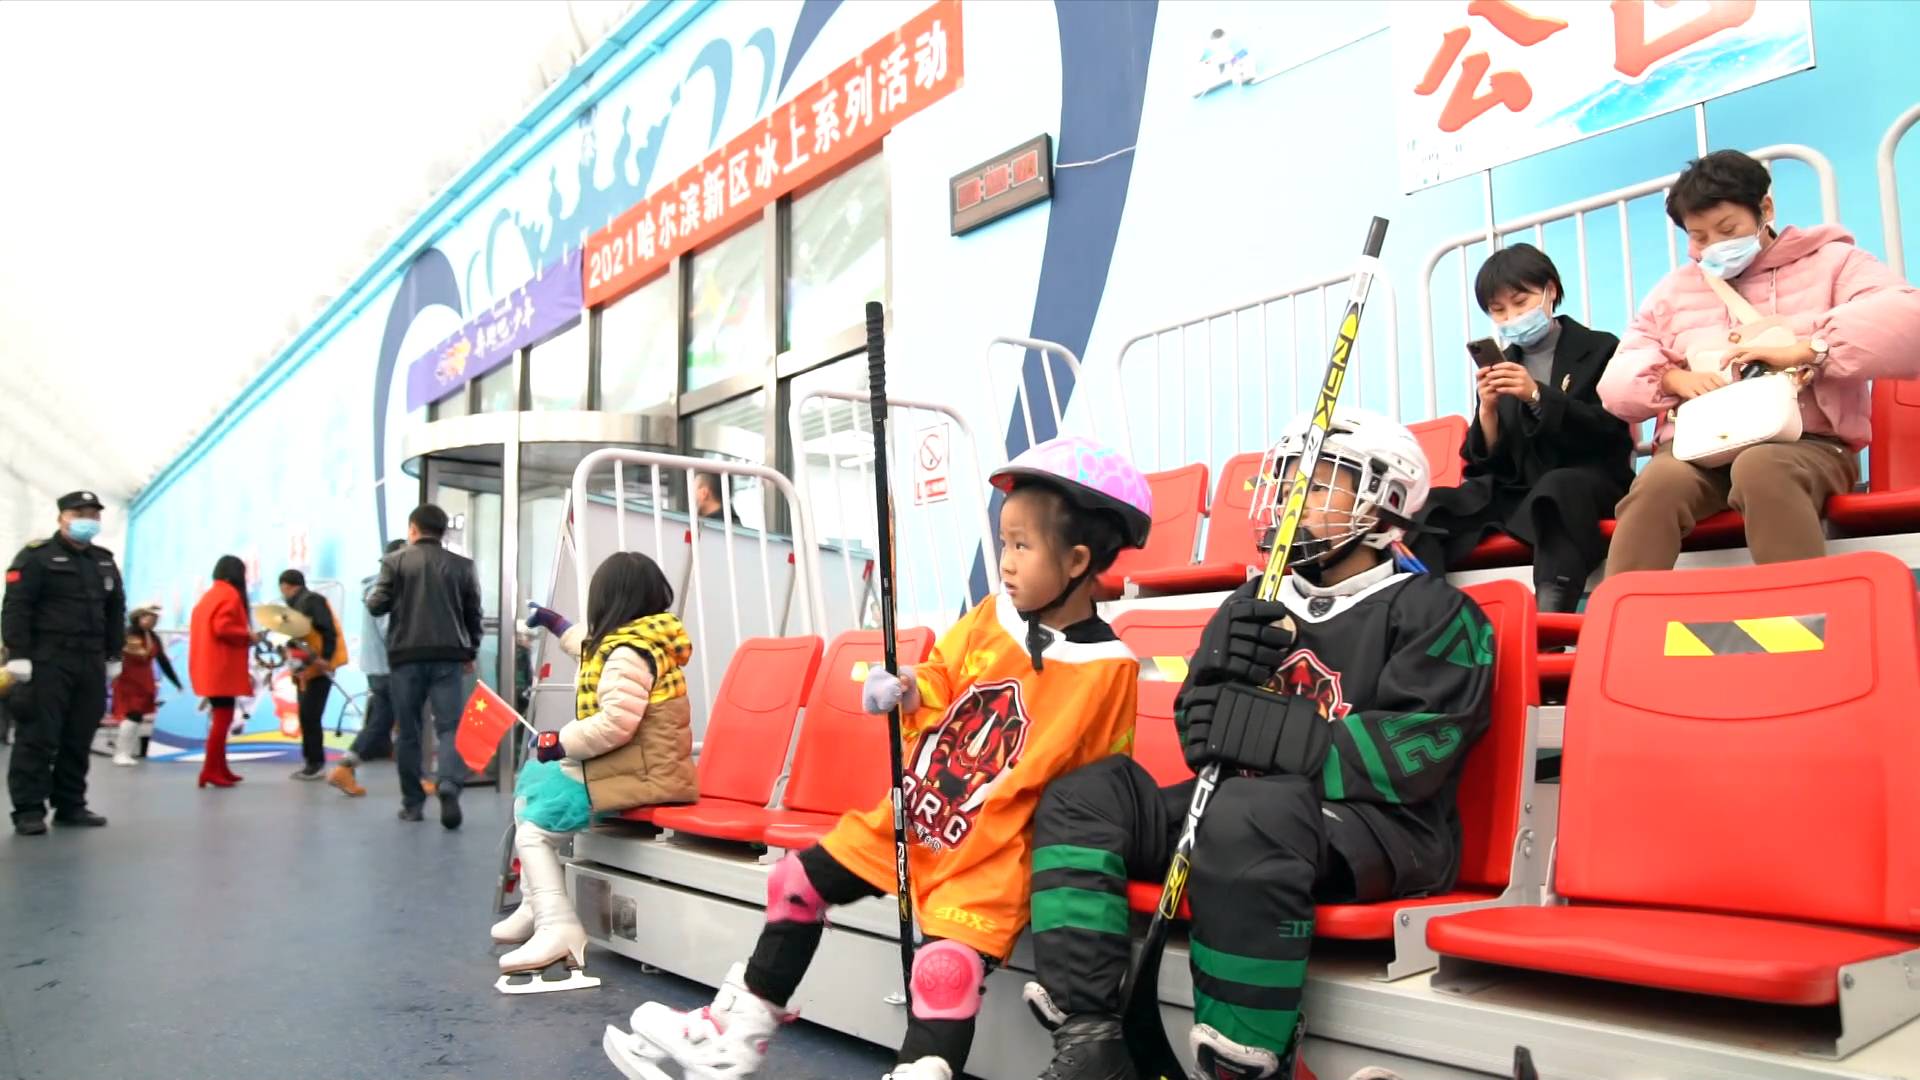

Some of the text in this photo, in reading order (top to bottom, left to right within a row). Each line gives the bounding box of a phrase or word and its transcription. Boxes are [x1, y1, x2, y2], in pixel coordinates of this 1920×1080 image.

[589, 20, 948, 289] 2021哈尔滨新区冰上系列活动
